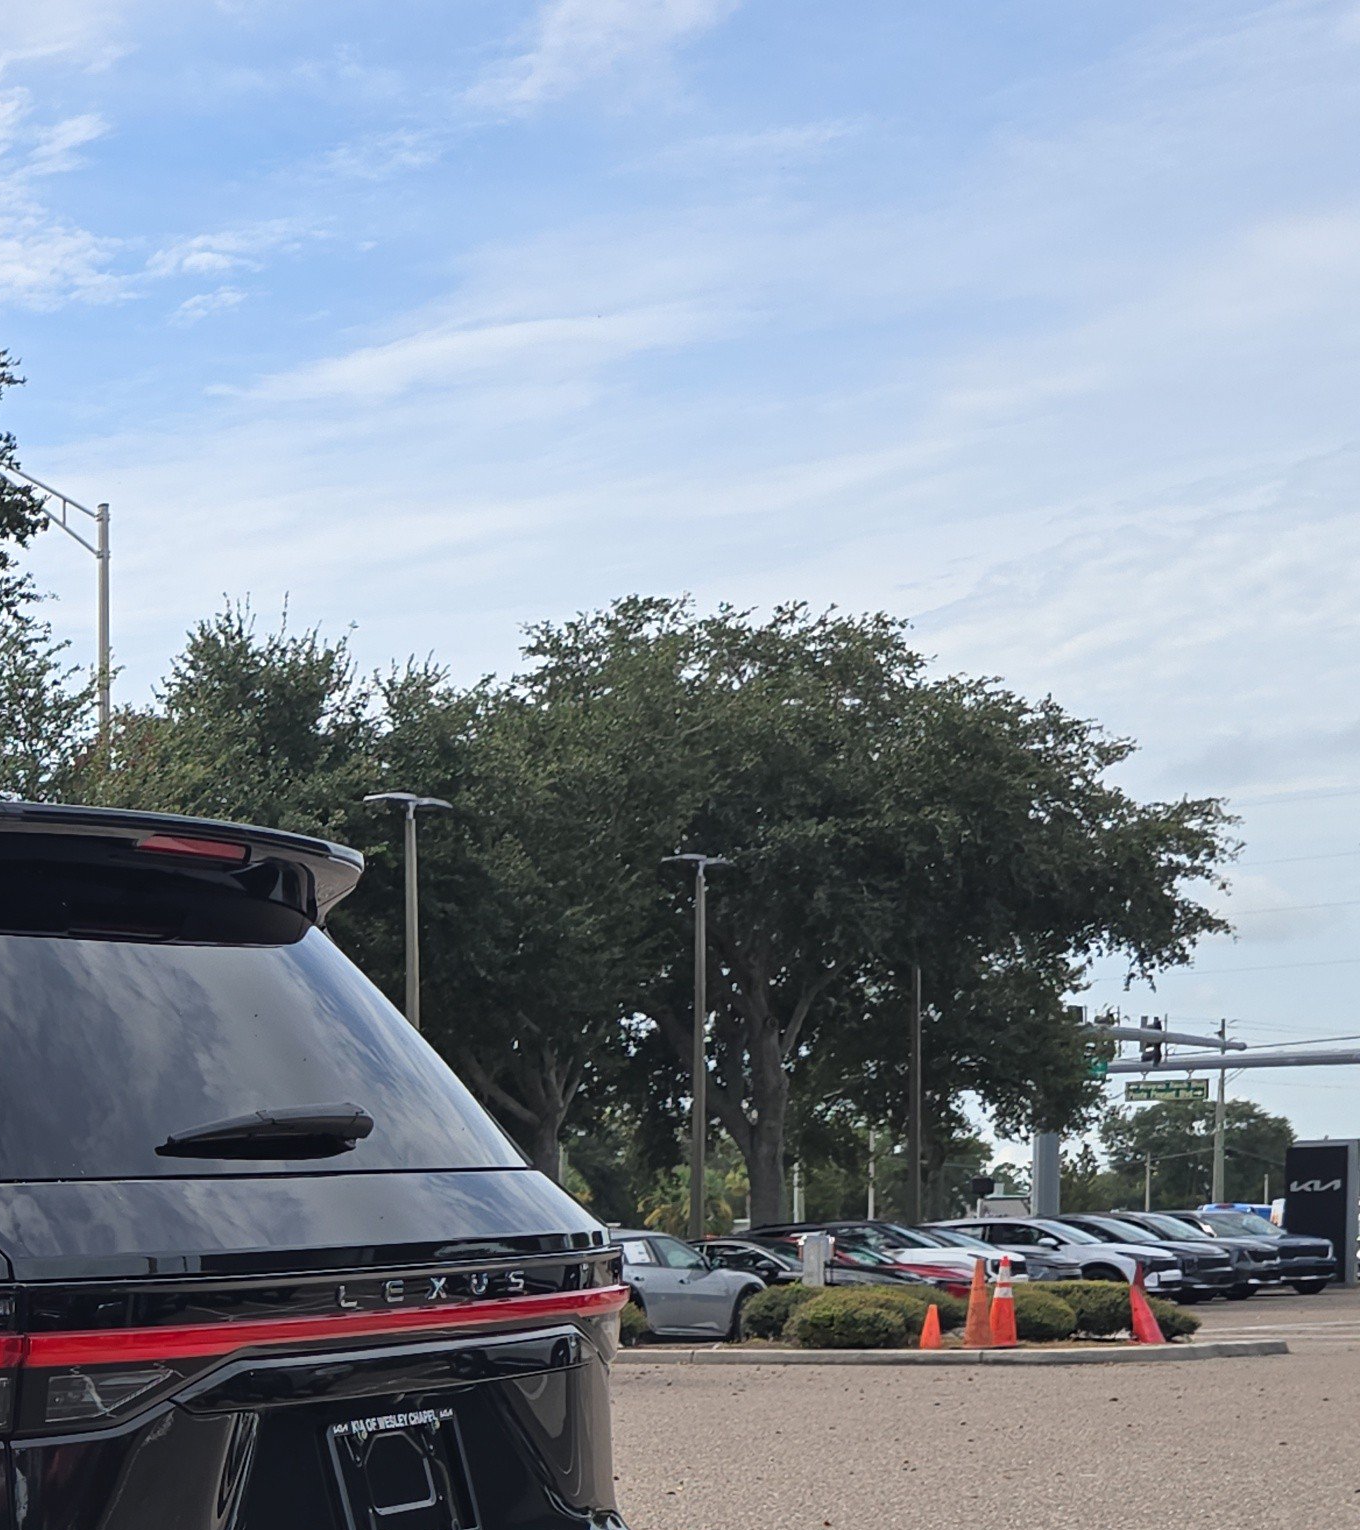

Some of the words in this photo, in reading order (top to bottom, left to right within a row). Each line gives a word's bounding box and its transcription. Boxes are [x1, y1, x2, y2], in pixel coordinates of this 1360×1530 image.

[337, 1270, 526, 1308] LEXUS
[366, 1417, 377, 1432] OF
[377, 1413, 407, 1430] WESLEY
[408, 1409, 437, 1425] CHAPEL
